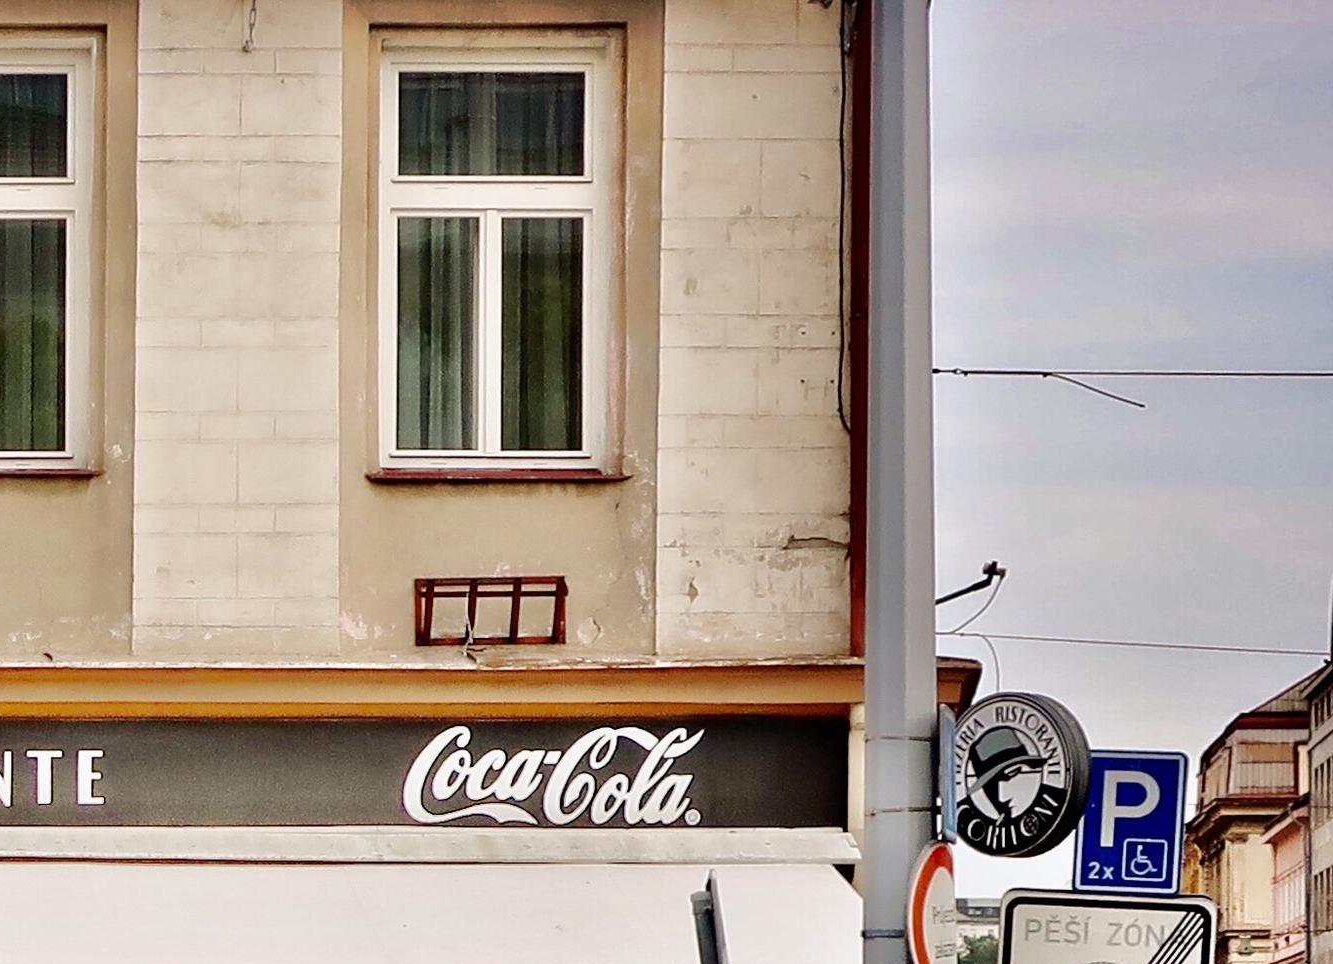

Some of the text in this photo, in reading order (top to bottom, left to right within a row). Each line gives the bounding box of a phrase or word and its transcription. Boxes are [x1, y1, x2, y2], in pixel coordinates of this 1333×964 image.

[403, 725, 705, 825] Coca-Cola
[1100, 770, 1161, 848] P
[1088, 862, 1115, 880] 2x
[1024, 914, 1168, 948] PĚŠÍ ZÓN
